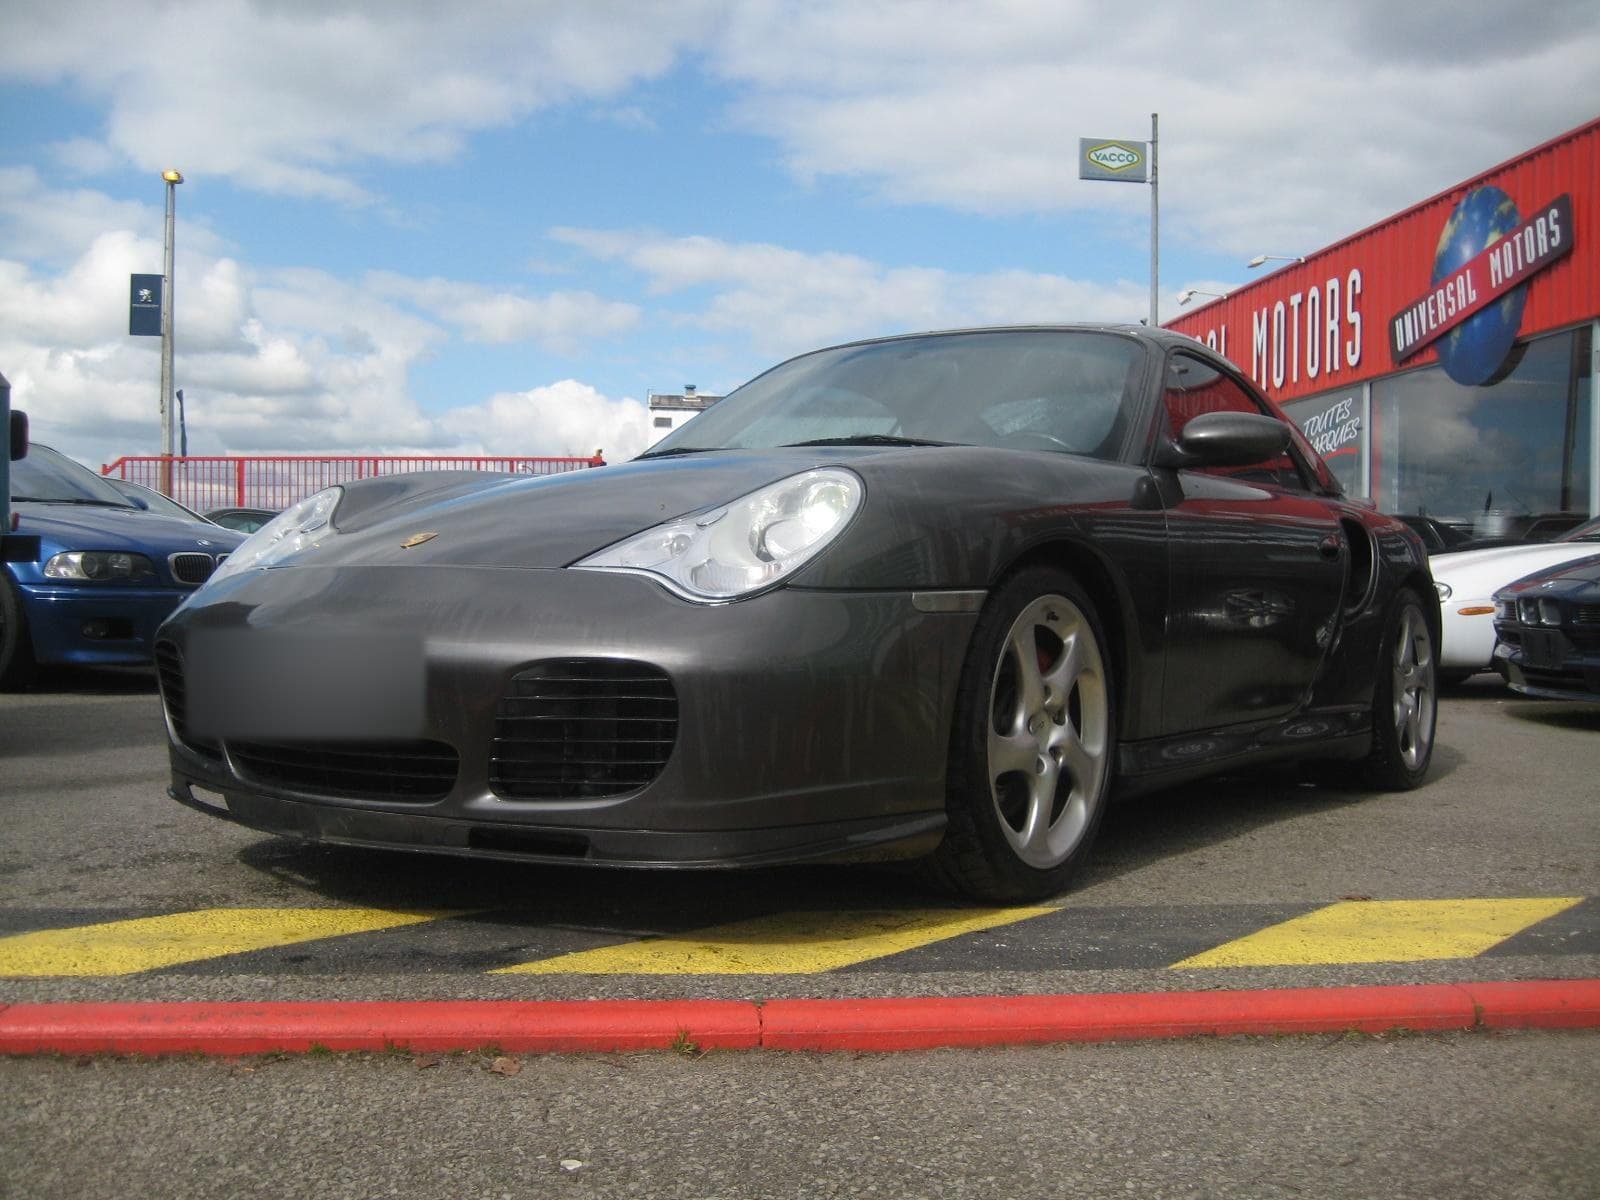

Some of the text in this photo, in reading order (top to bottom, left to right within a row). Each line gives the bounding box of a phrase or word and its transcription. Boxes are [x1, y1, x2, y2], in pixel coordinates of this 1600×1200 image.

[1094, 152, 1135, 162] YACCO
[1395, 208, 1561, 352] UNIVERSAL MOTORS
[1252, 268, 1362, 391] MOTORS
[1304, 397, 1353, 437] TOUTES
[1310, 416, 1360, 455] ARQUES
